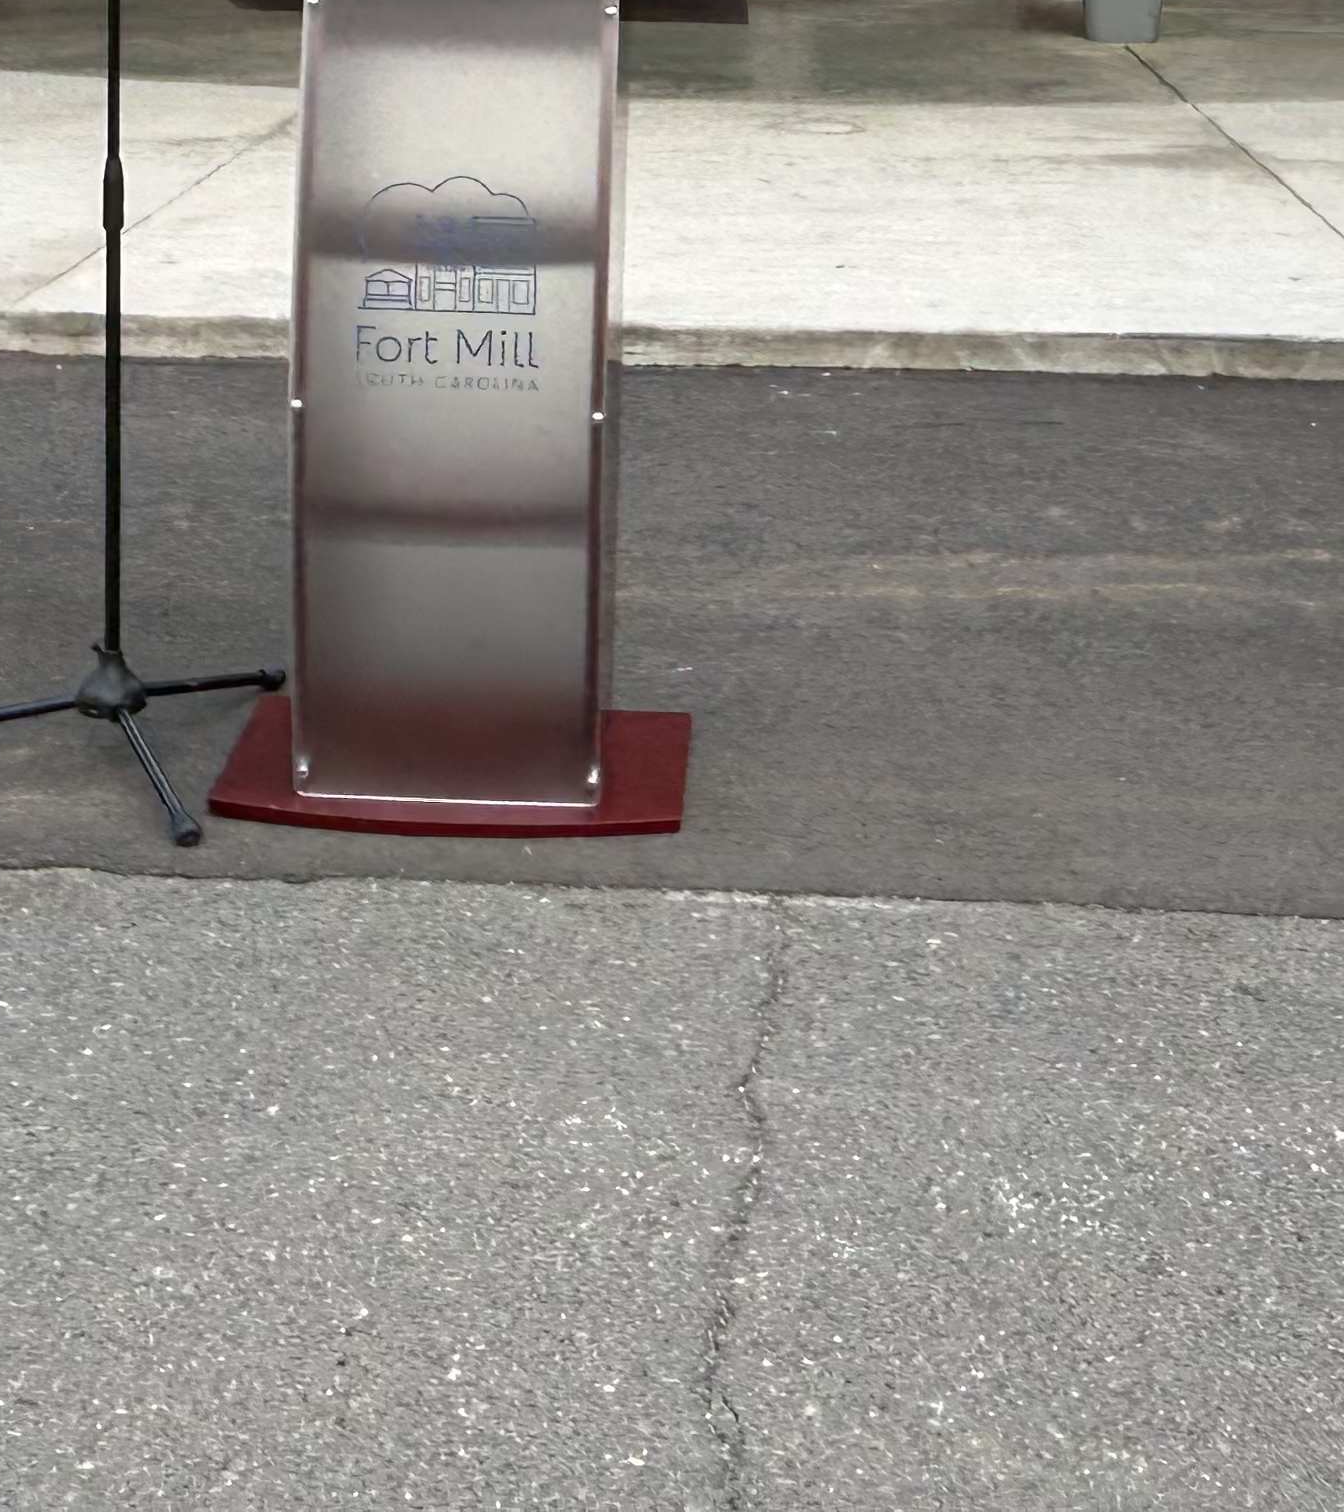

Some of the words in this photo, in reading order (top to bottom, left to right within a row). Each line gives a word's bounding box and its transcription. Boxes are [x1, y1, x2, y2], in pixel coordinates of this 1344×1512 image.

[355, 325, 438, 365] Fort
[456, 328, 539, 369] Mill
[434, 375, 540, 392] CAROLINA
